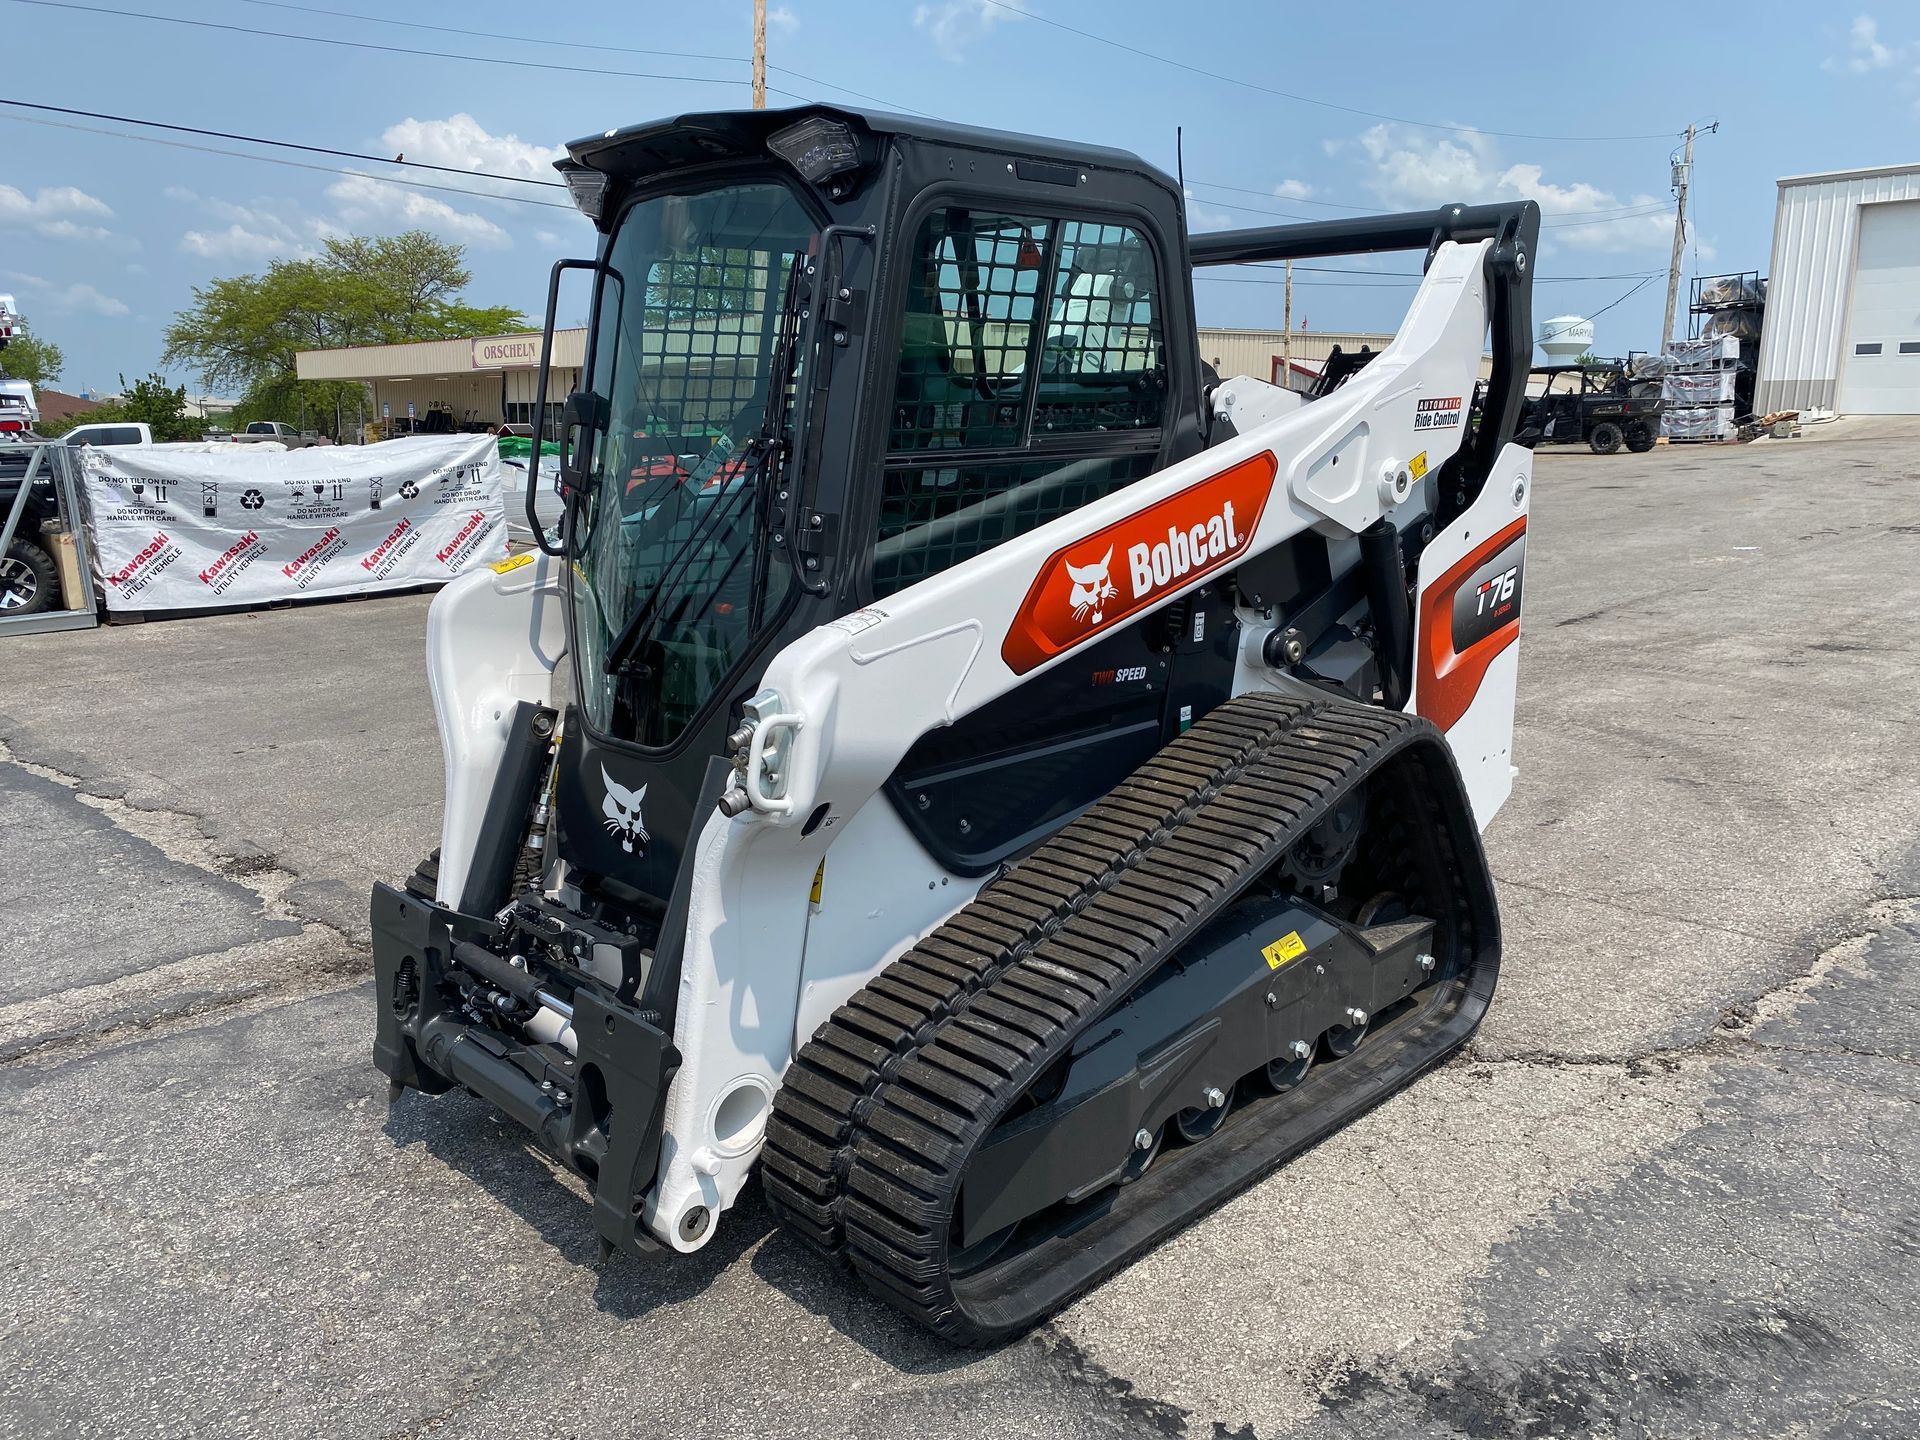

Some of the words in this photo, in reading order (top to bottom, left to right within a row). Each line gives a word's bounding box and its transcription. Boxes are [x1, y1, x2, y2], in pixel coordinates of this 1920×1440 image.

[484, 343, 535, 360] ORSCHELN
[1414, 412, 1432, 427] Ride
[1433, 411, 1460, 426] Control
[1418, 400, 1460, 410] AUTOMATIC
[206, 496, 214, 504] 4
[106, 531, 169, 587] Kawasaki
[198, 530, 259, 584] Kawasaki
[281, 527, 340, 578] Kawasaki
[361, 517, 411, 571] Kawasaki
[376, 556, 399, 581] UTILITY
[396, 530, 422, 558] VEHICLE
[436, 509, 486, 563] Kawasaki
[450, 549, 471, 573] UTILITY
[470, 523, 494, 550] VEHICLE
[1128, 500, 1237, 599] Bobcat
[123, 574, 153, 600] UTILITY
[150, 548, 183, 576] VEHICLE
[213, 570, 240, 596] UTILITY
[238, 544, 268, 571] VEHICLE
[298, 565, 321, 589] UTILITY
[319, 539, 349, 566] VEHICLE
[1476, 566, 1517, 616] T76
[1093, 670, 1115, 685] TWO
[1116, 666, 1146, 682] SPEED
